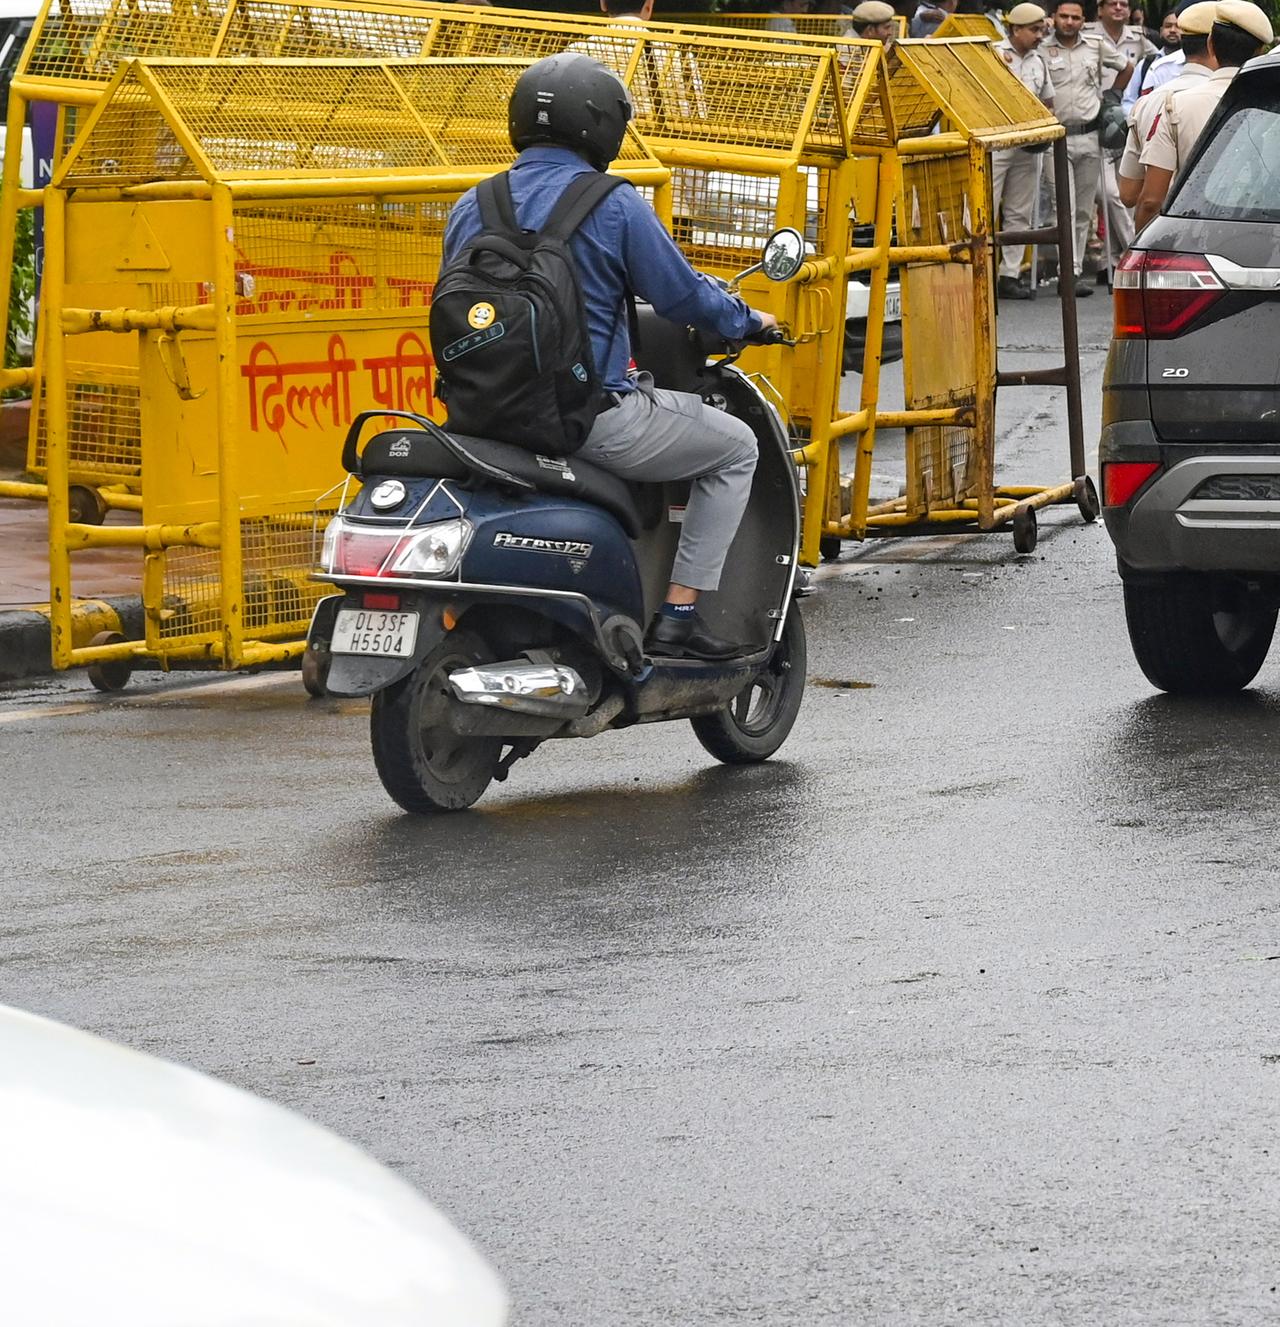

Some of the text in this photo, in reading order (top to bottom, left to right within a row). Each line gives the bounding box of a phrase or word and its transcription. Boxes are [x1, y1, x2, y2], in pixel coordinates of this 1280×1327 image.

[240, 333, 357, 454] दिल्ली
[355, 612, 409, 632] DL3SF
[350, 632, 403, 653] H5504
